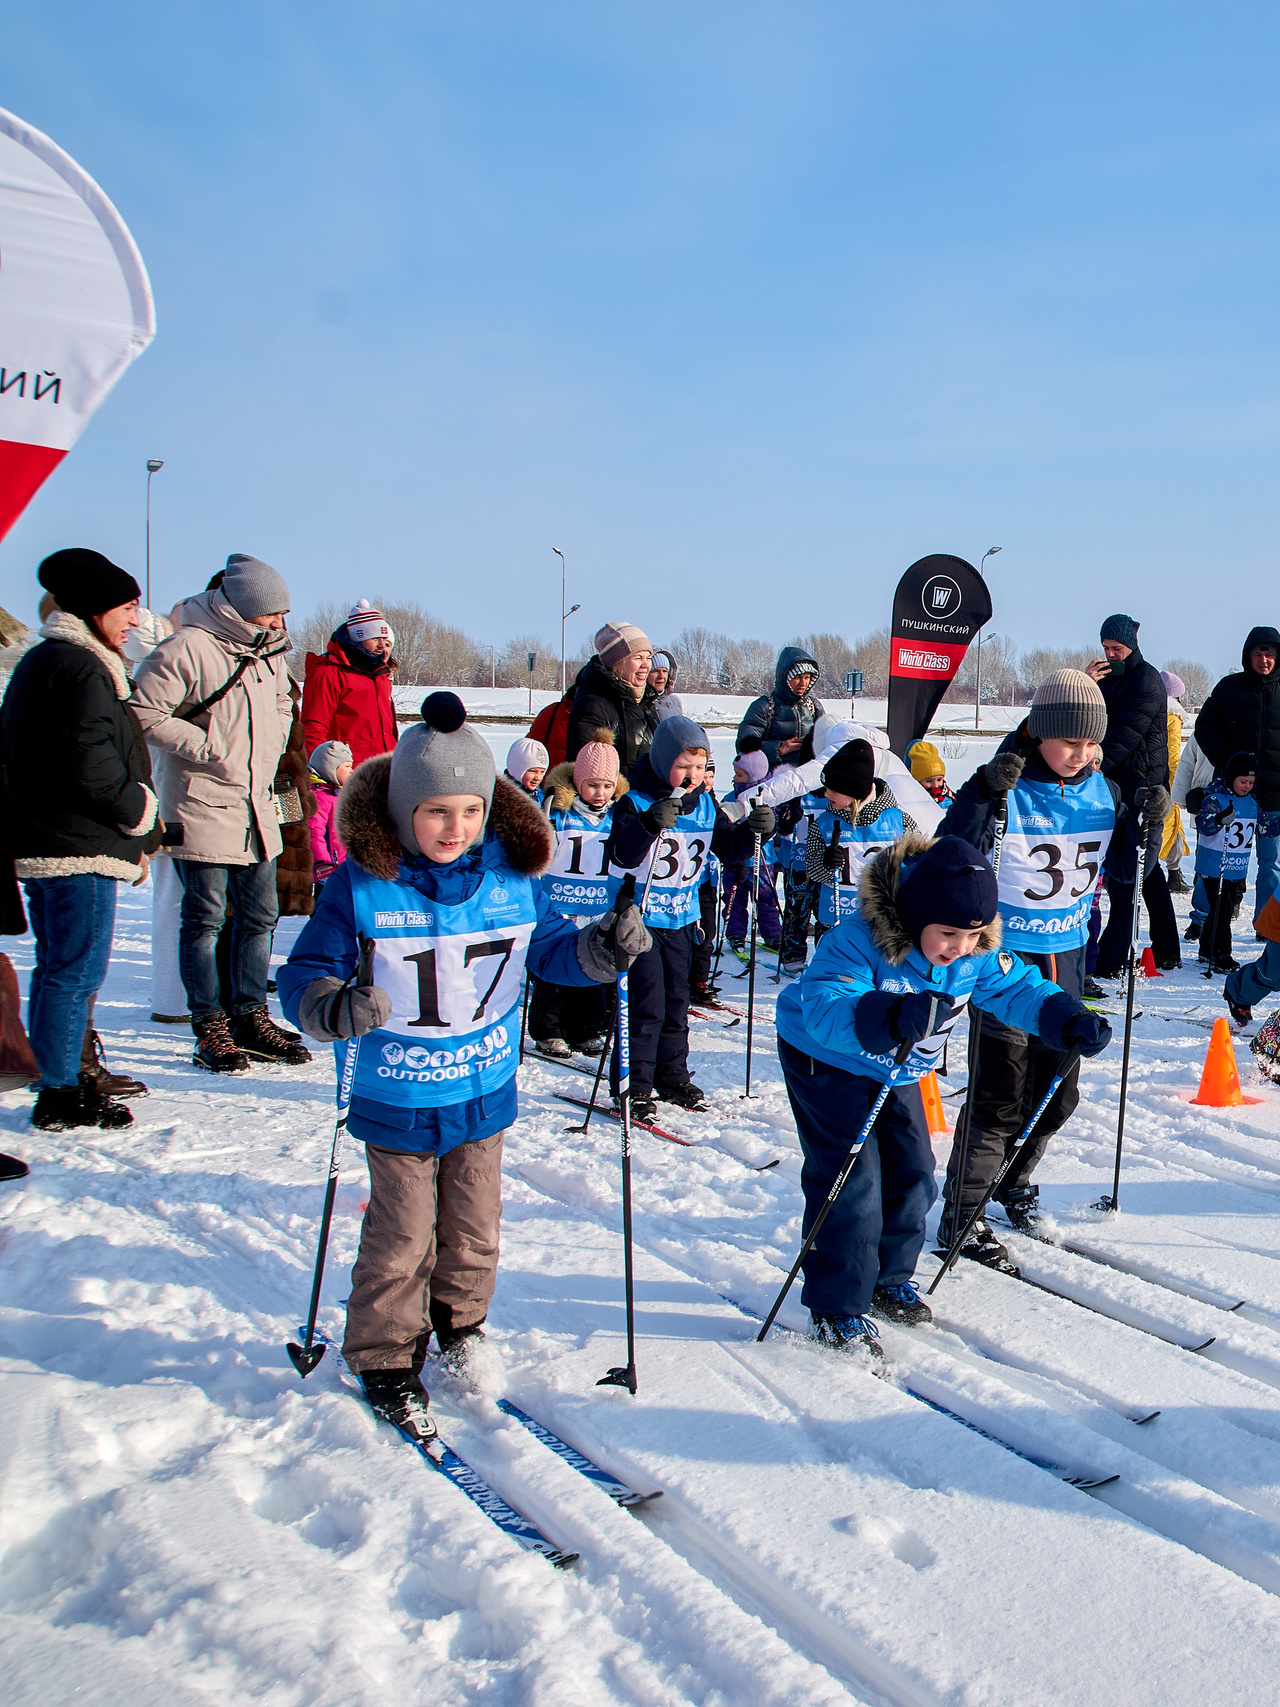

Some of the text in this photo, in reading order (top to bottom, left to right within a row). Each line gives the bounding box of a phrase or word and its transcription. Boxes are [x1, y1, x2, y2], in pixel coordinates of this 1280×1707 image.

[901, 618, 970, 635] ПУШКИНСКИЙ
[900, 650, 949, 670] World Class
[1034, 816, 1054, 827] Class
[1228, 821, 1255, 849] 32
[652, 838, 706, 882] 33
[1024, 841, 1102, 901] 35
[550, 893, 608, 906] OUTDOOR TEA
[1137, 865, 1145, 904] NORDWAY
[376, 912, 432, 926] World Class
[403, 938, 517, 1028] 17
[881, 980, 904, 992] World
[620, 999, 630, 1068] NORDWAY
[339, 1041, 358, 1103] NORDWAY
[377, 1045, 512, 1082] OUTDOOR TEAM
[904, 1065, 928, 1079] TEA
[862, 1084, 890, 1137] NORDWAY
[827, 1170, 844, 1201] NORDWAY
[994, 1160, 1010, 1184] NORDWAY
[522, 1419, 600, 1472] NORDWAY
[447, 1465, 526, 1529] NORDWAY
